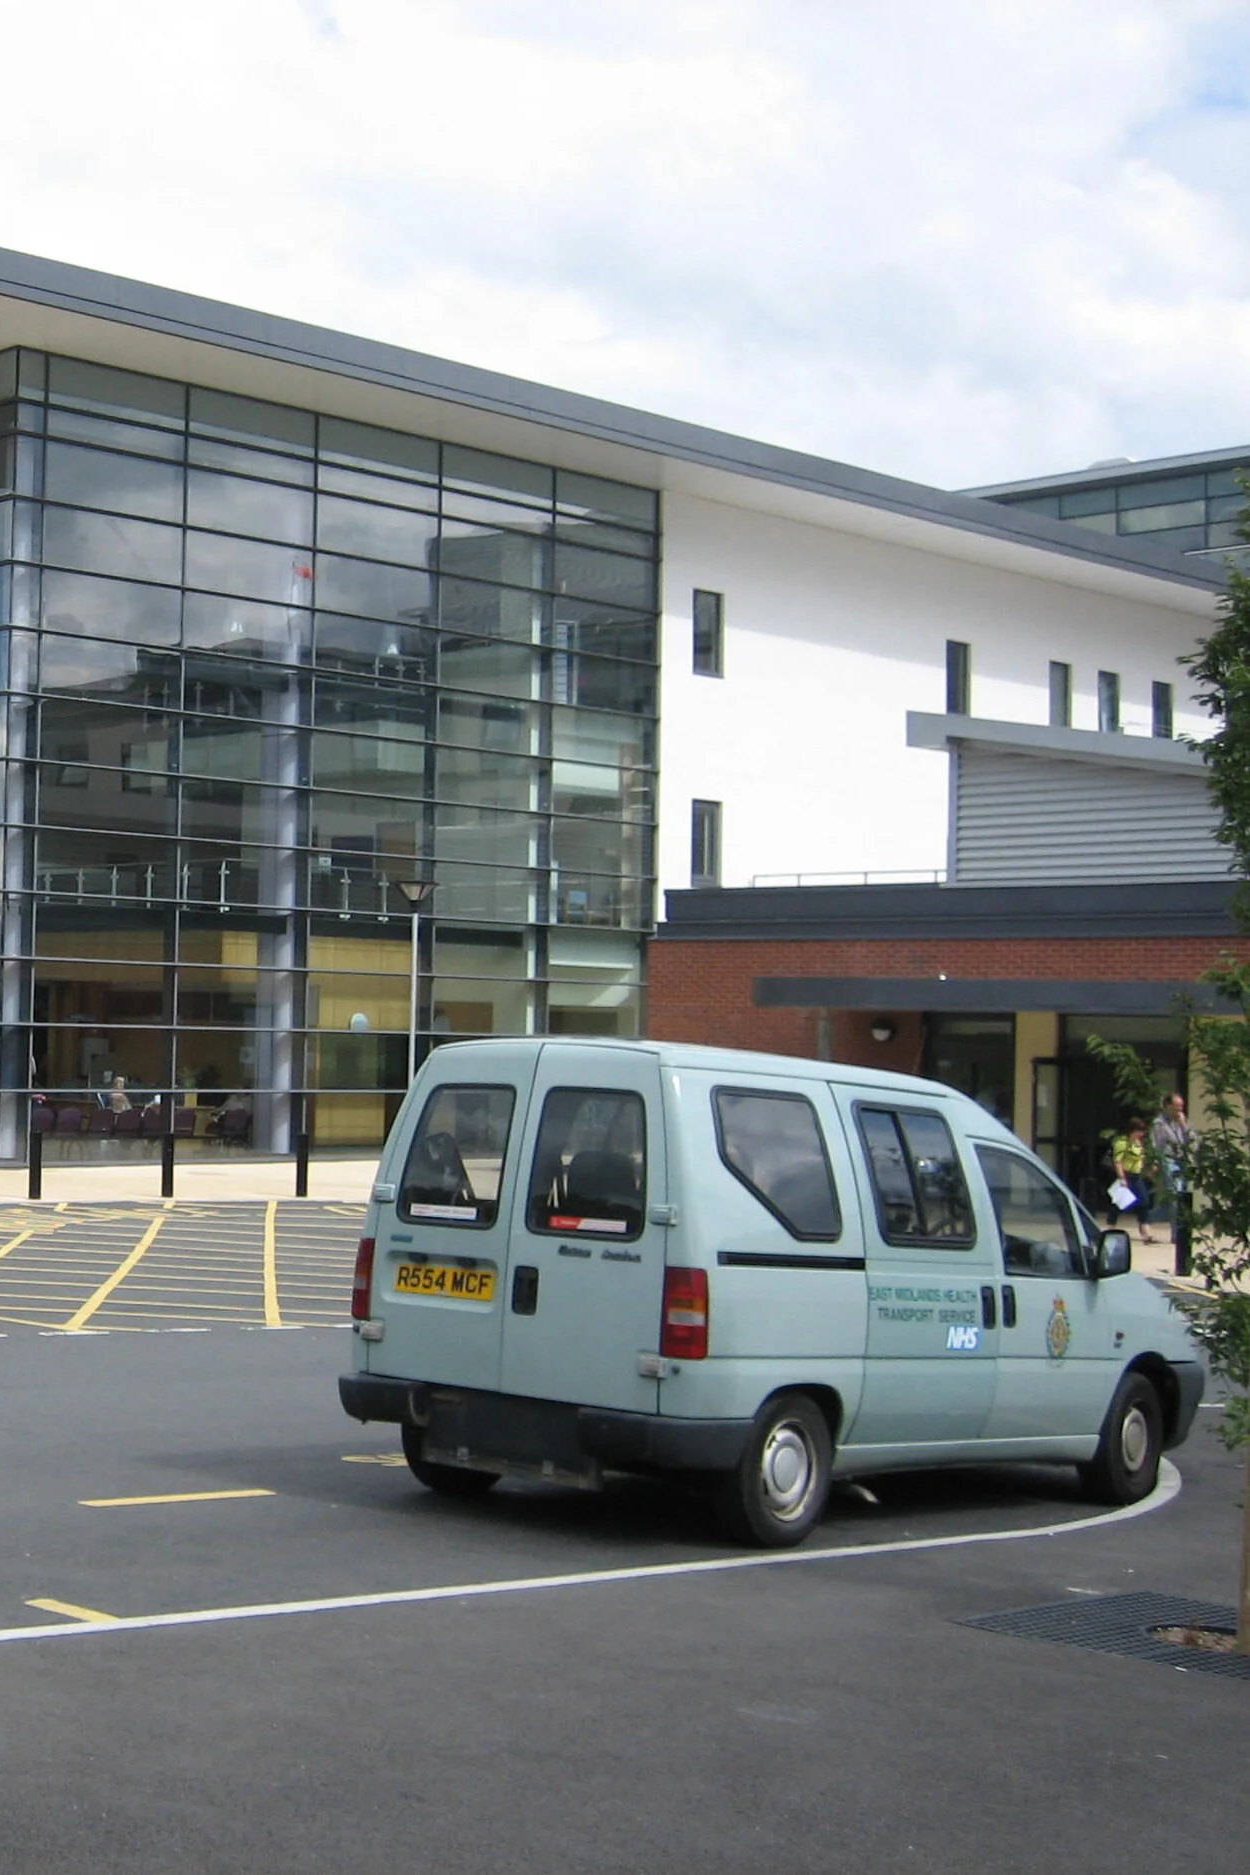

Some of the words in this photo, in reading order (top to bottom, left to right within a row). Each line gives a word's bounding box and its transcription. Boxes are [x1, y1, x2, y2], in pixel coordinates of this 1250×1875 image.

[397, 1266, 447, 1291] R554
[451, 1271, 492, 1295] MCF
[870, 1286, 893, 1301] EAST
[895, 1287, 941, 1302] MIDLANDS
[941, 1288, 977, 1303] HEALTH
[877, 1307, 934, 1322] TRANSPORT
[937, 1308, 976, 1324] SERVICE
[946, 1326, 980, 1350] NHS
